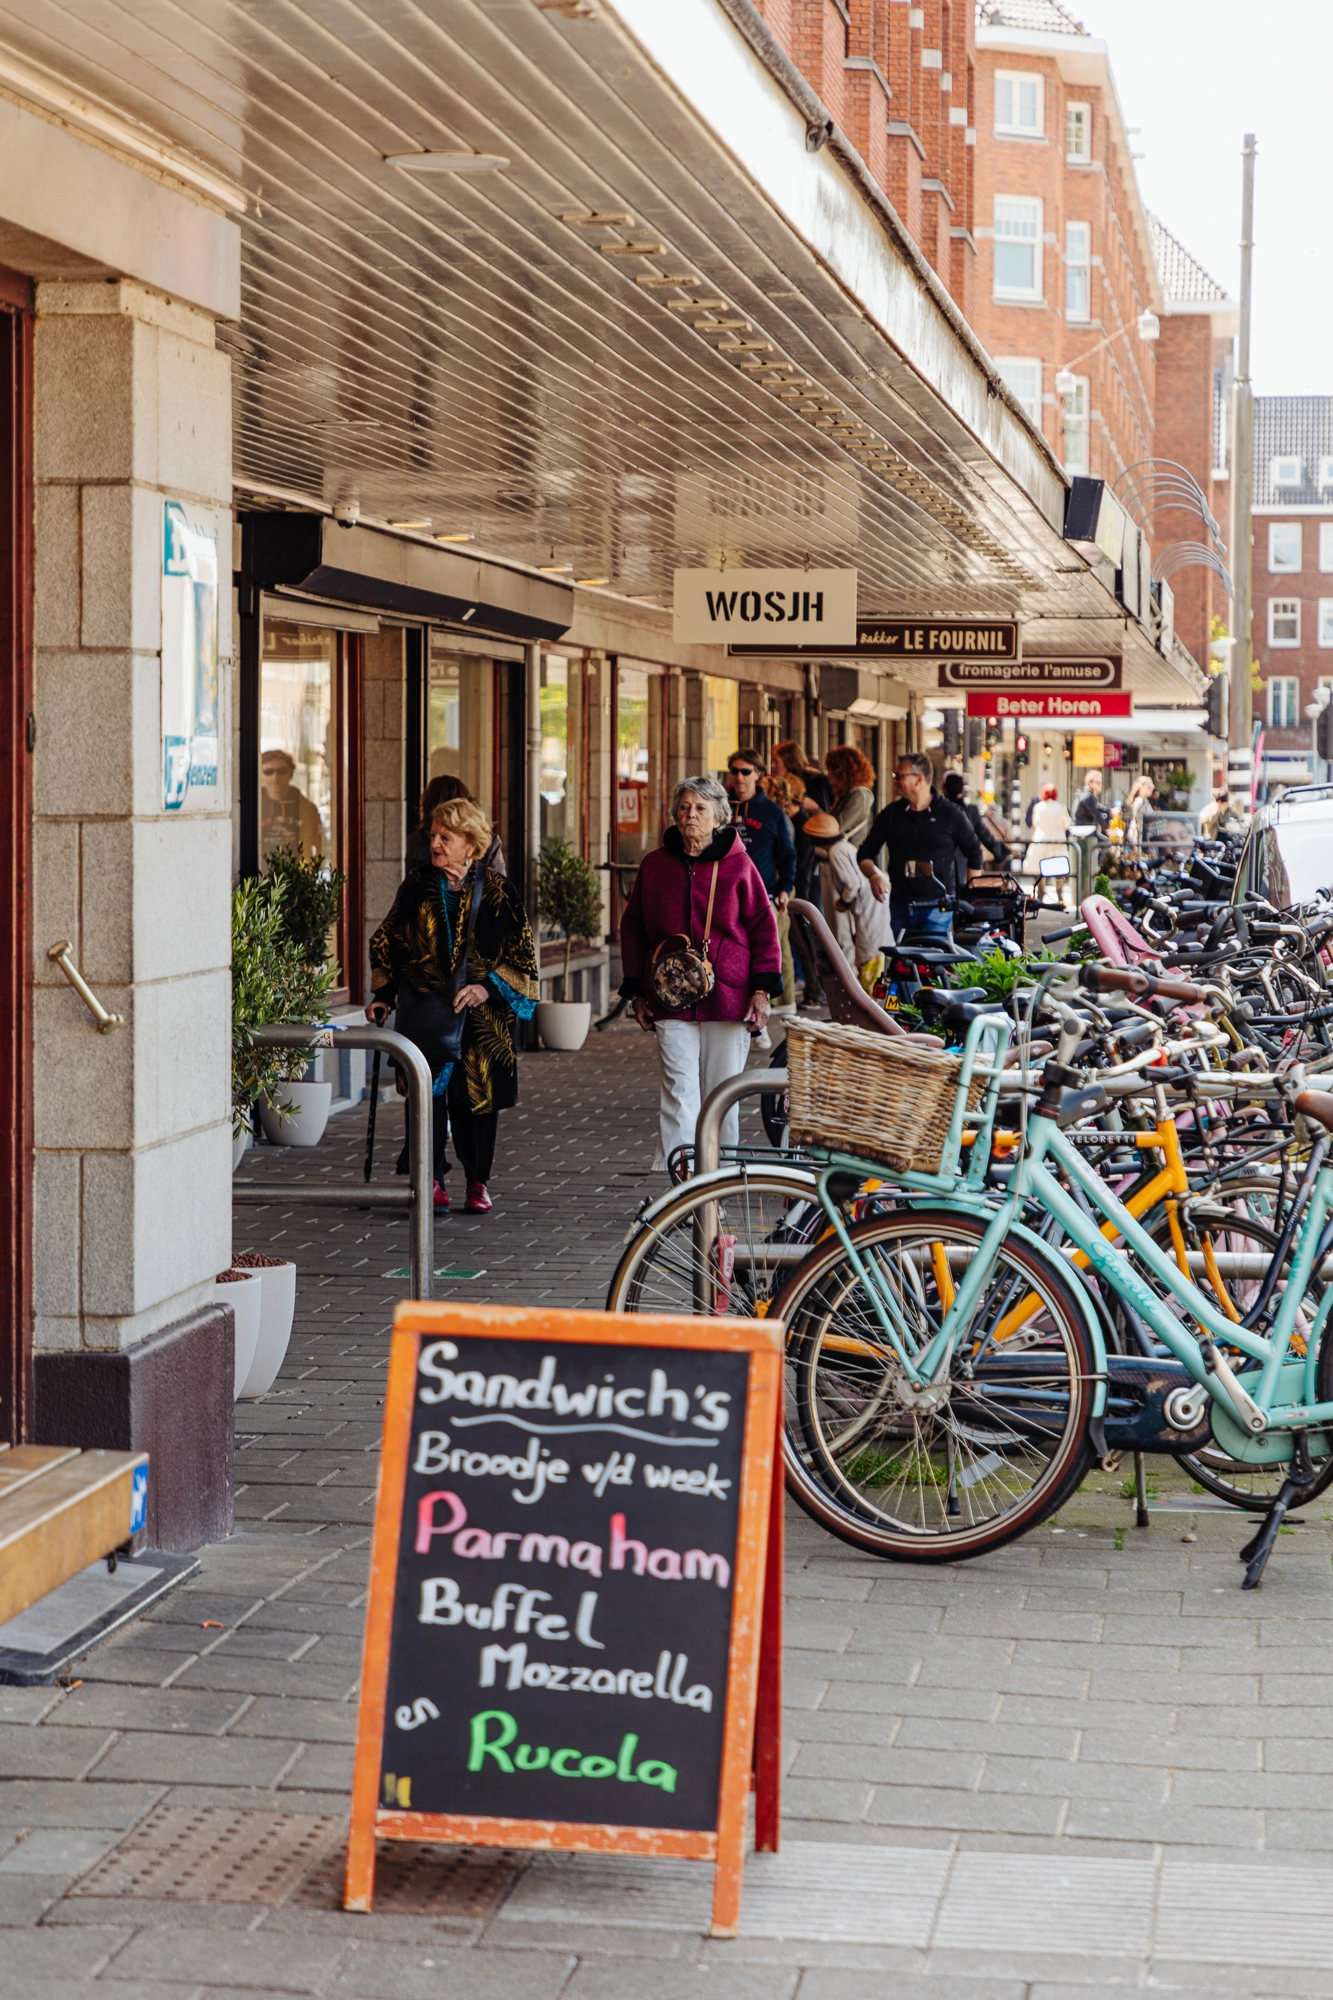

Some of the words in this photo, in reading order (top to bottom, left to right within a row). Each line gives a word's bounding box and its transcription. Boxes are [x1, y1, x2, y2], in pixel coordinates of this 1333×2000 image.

[705, 591, 824, 622] WOSJH
[859, 631, 899, 646] Bakker
[904, 630, 924, 650] LE
[929, 630, 1007, 651] FOURNIL
[958, 663, 1040, 680] fromagerie
[1044, 663, 1102, 677] l'amuse
[996, 697, 1044, 714] Beter
[1048, 697, 1102, 715] Horen
[1069, 1135, 1135, 1144] VELORETTI
[1091, 1241, 1157, 1316] Gazelle
[418, 1341, 732, 1431] Sandwich's
[413, 1431, 570, 1504] Broodje
[582, 1451, 636, 1498] v/d
[643, 1462, 732, 1500] week
[418, 1577, 605, 1649] Buffel
[479, 1643, 713, 1713] Mozzarella
[467, 1710, 678, 1793] Rucola
